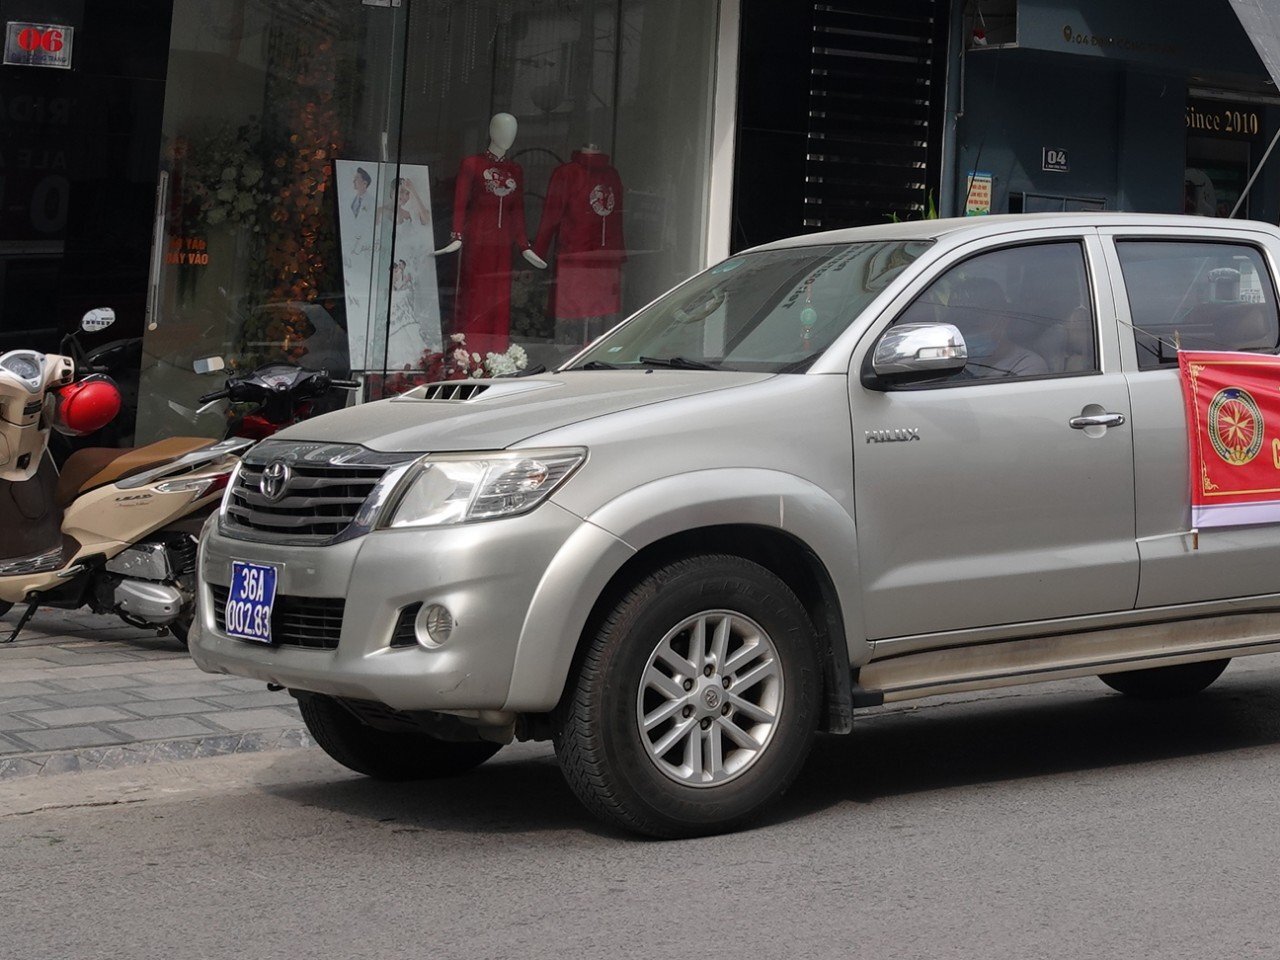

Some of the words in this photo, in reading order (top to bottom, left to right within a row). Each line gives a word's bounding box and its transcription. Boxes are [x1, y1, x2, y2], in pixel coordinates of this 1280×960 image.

[17, 27, 63, 52] 06
[1225, 111, 1258, 135] 2010
[1047, 150, 1066, 165] 04
[240, 568, 264, 601] 36A
[228, 599, 270, 637] 002.83
